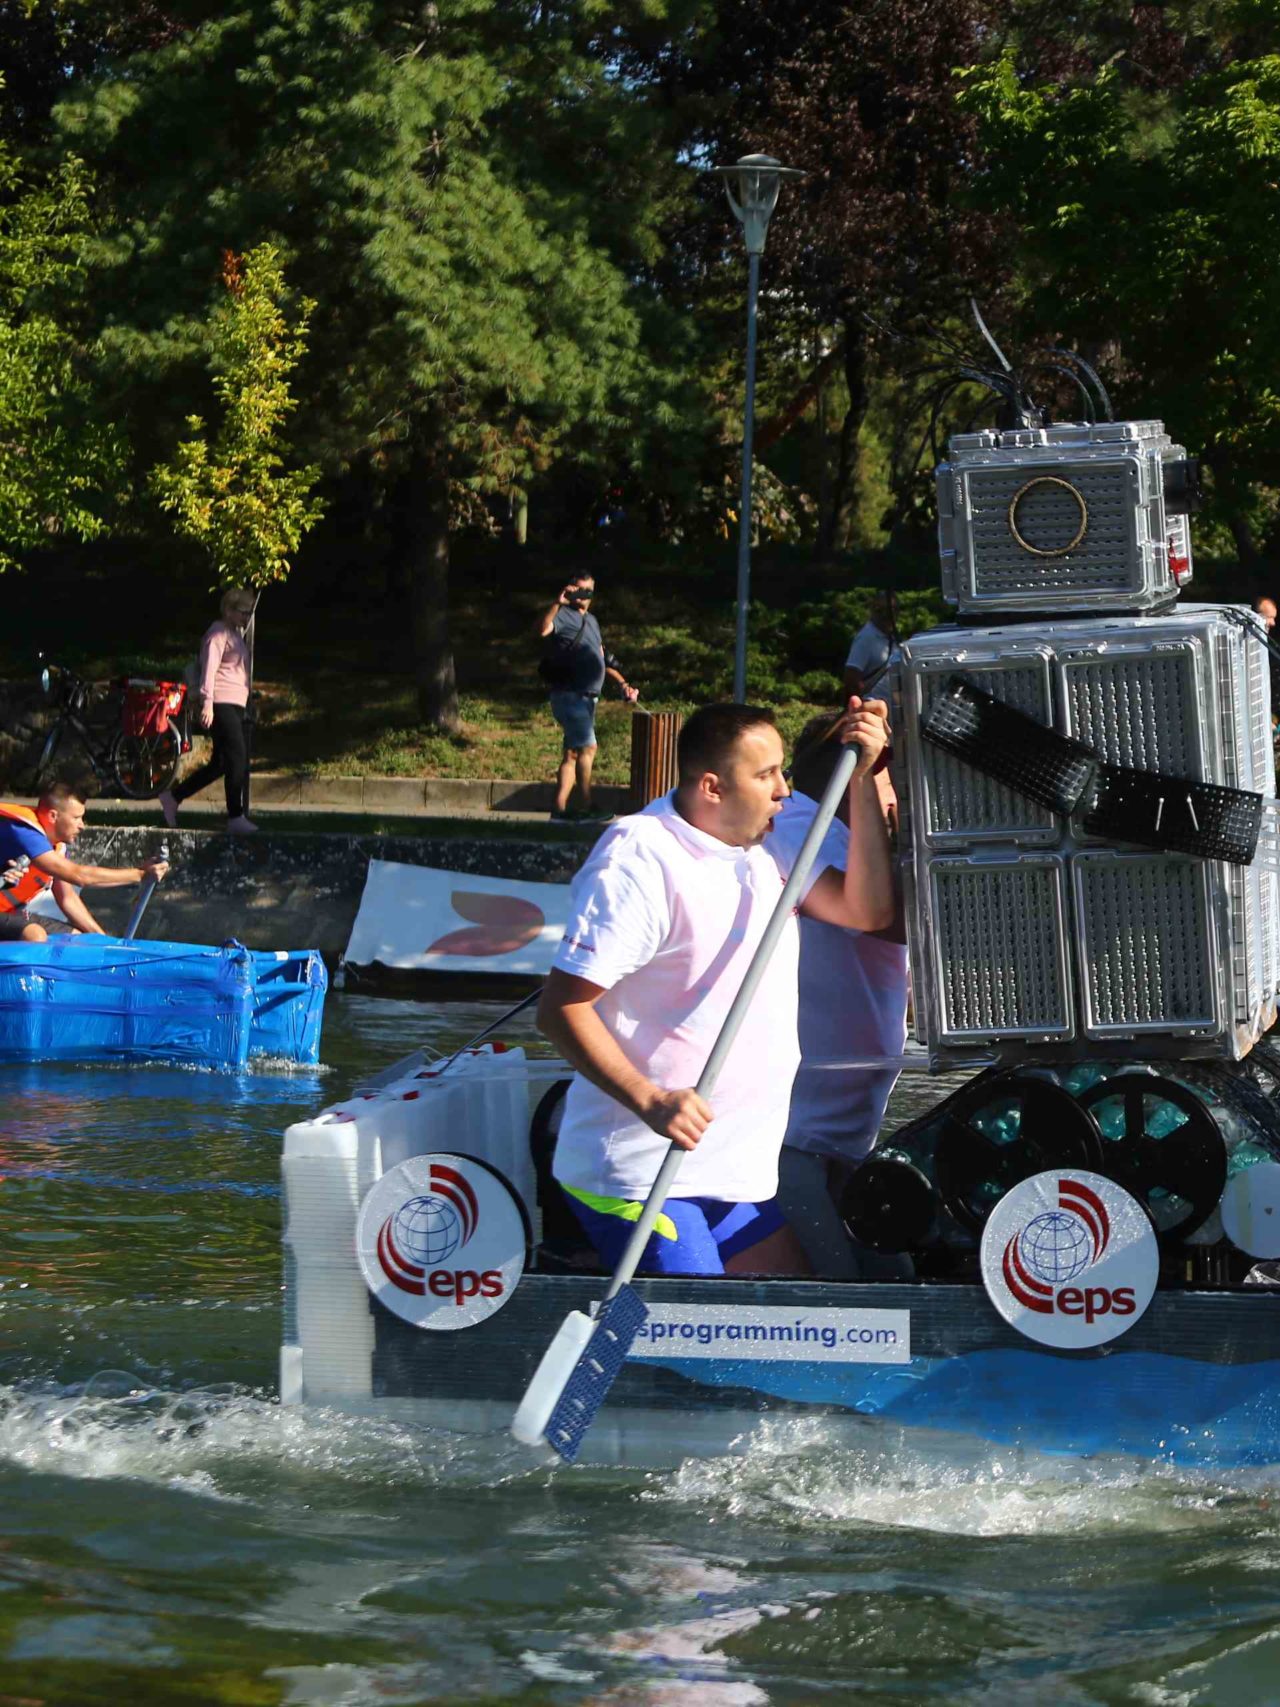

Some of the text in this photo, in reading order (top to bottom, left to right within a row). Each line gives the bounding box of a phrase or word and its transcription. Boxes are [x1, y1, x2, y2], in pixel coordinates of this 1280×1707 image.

[428, 1269, 504, 1306] eps
[1056, 1287, 1136, 1324] eps
[635, 1320, 898, 1348] sprogramming.com
